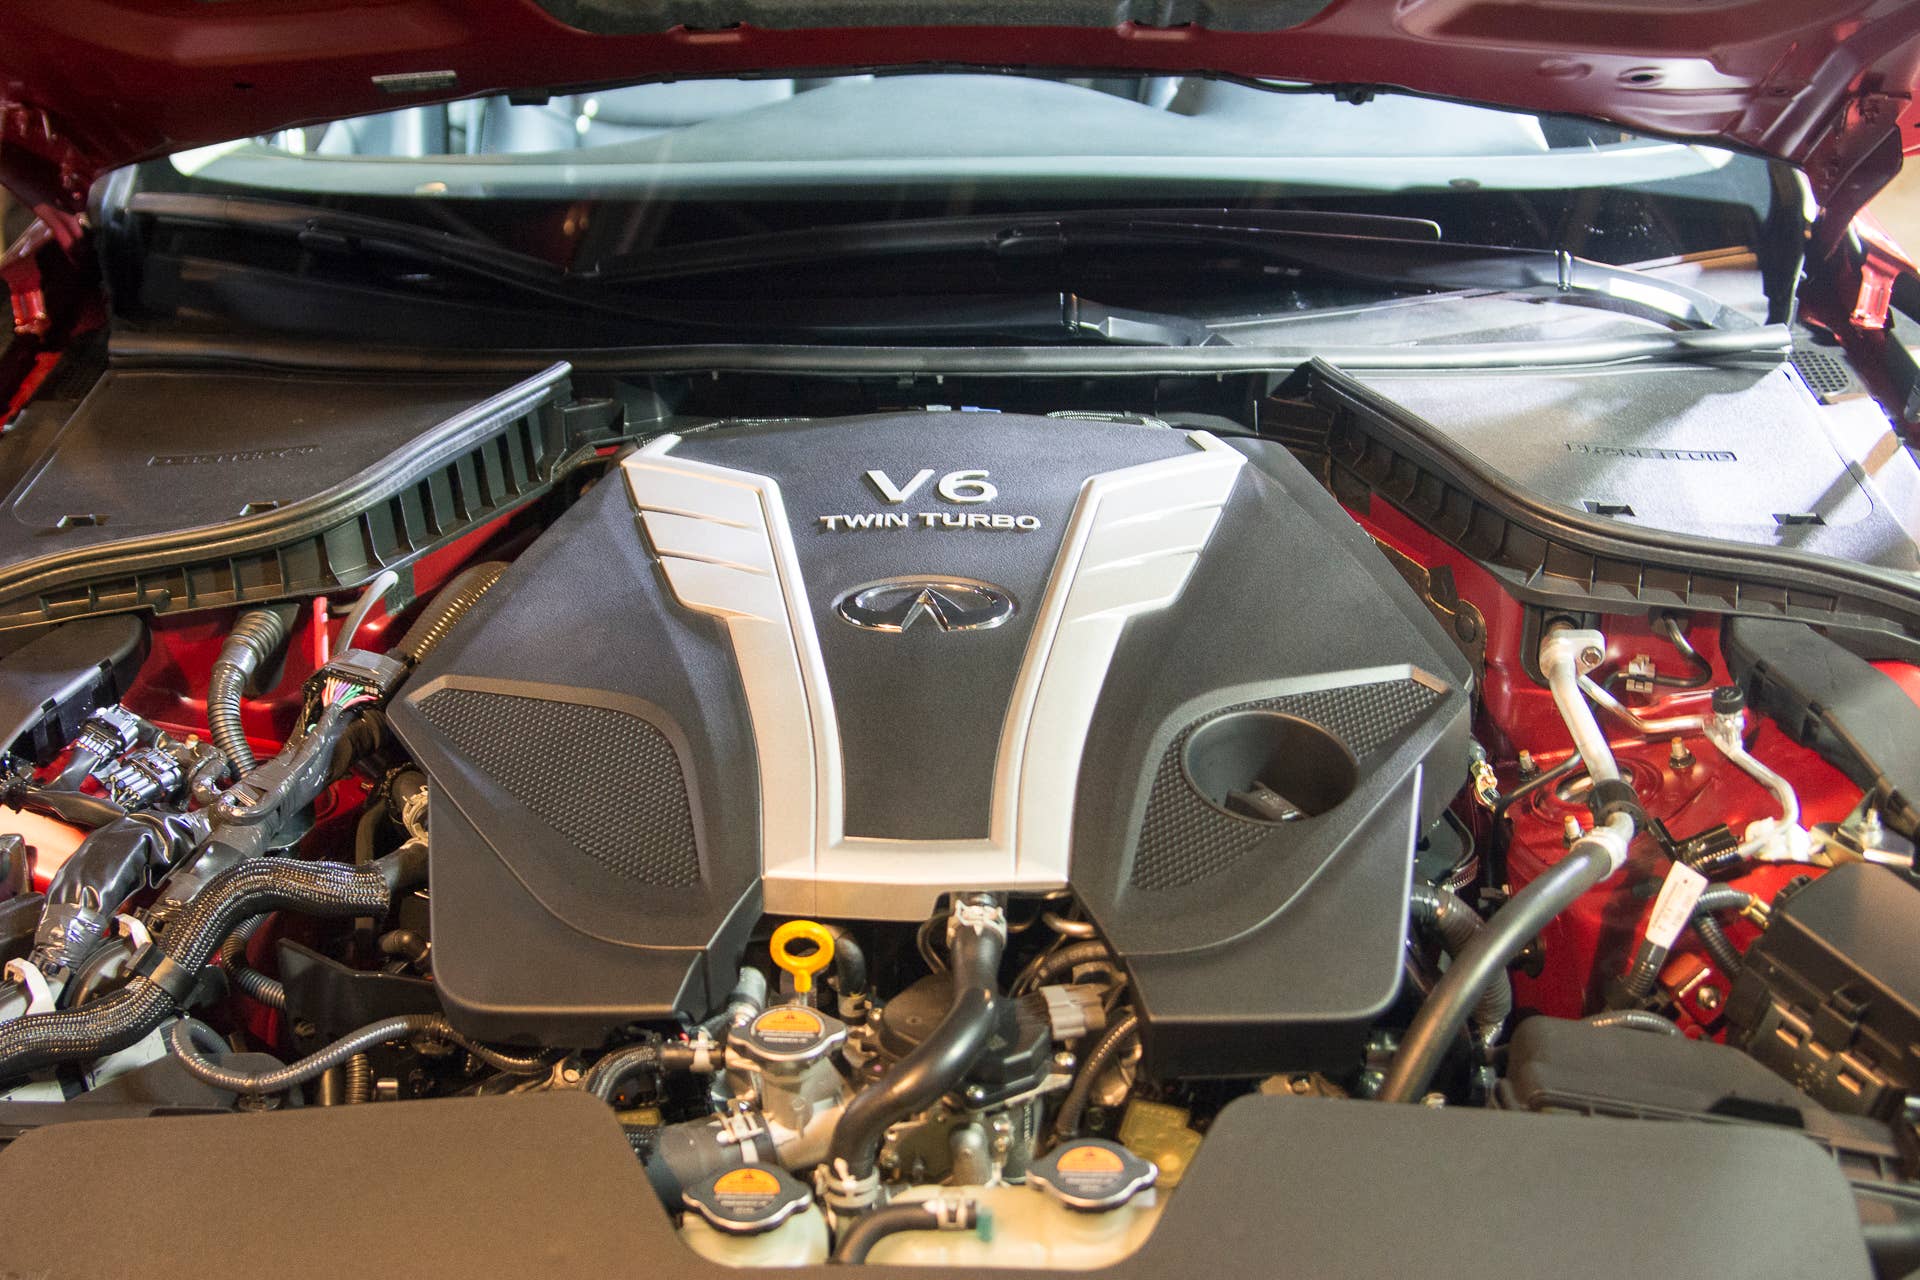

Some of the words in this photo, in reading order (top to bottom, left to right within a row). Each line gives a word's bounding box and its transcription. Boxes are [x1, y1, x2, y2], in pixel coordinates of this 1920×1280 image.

[866, 468, 998, 503] V6
[820, 513, 908, 531] TWIN
[918, 512, 1041, 530] TURBO
